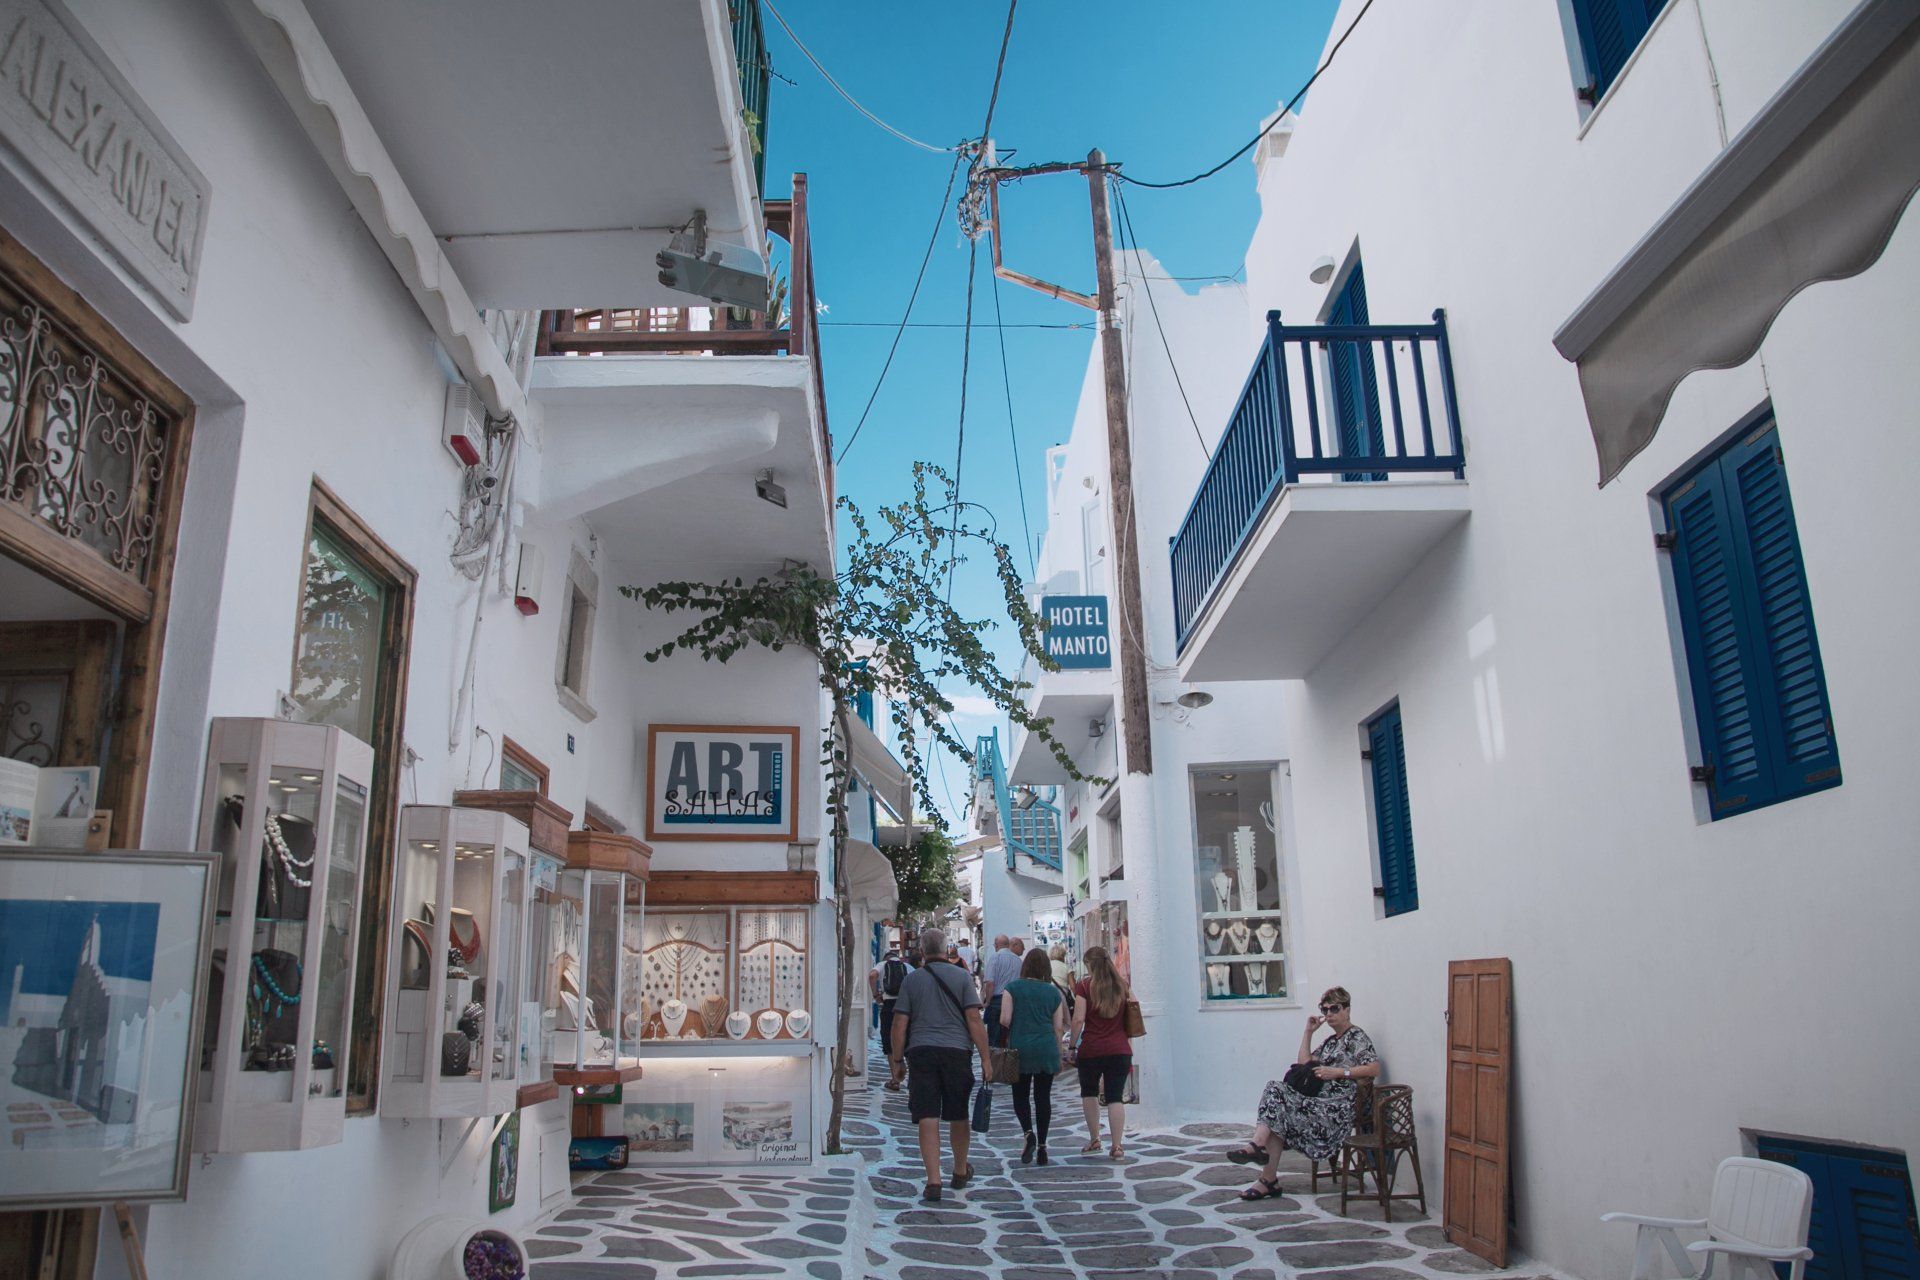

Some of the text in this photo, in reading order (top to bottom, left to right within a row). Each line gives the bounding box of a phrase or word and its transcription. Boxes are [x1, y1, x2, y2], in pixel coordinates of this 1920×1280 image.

[1049, 606, 1104, 626] HOTEL
[1049, 635, 1108, 656] MANTO
[664, 741, 783, 801] ART
[665, 787, 780, 820] SAHAS
[761, 1143, 798, 1156] Original
